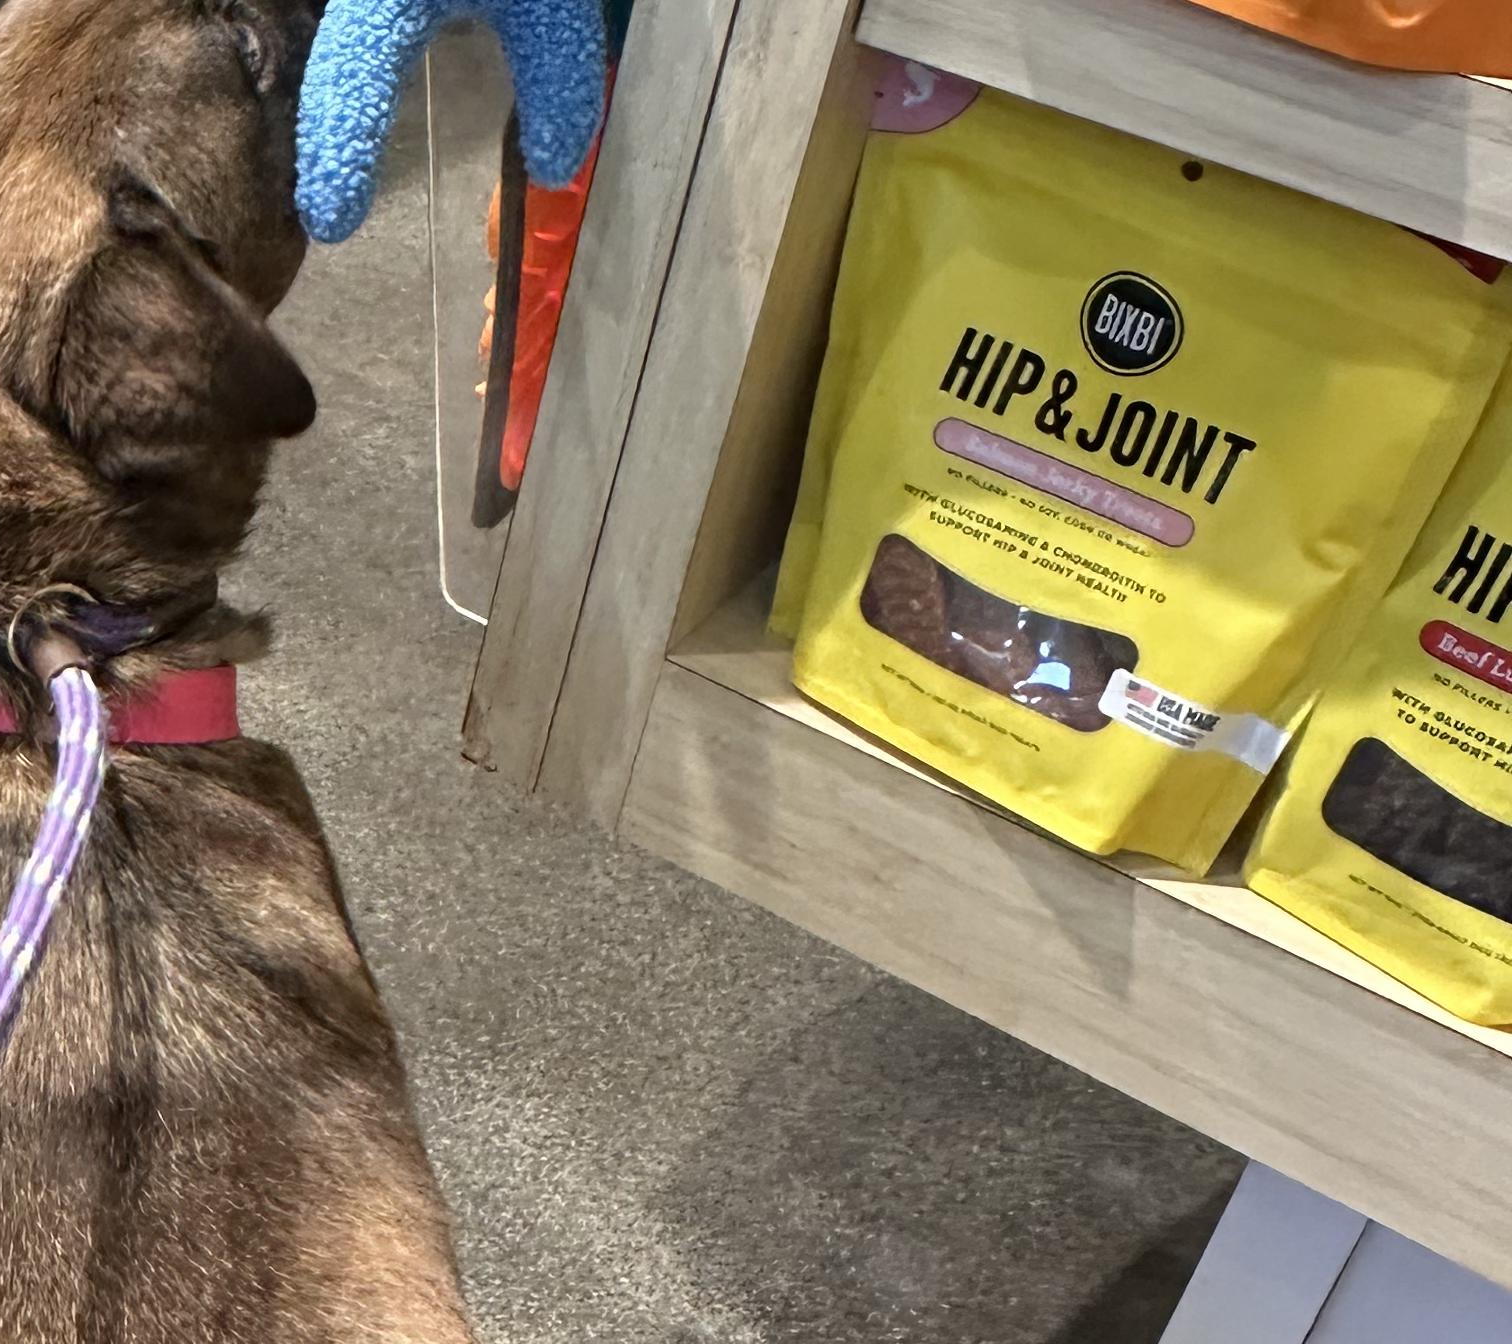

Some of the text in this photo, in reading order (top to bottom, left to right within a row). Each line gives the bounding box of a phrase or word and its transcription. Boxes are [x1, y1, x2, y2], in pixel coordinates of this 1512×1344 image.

[1095, 293, 1165, 355] BIXBI
[939, 327, 1257, 504] HIP & JOINT
[929, 510, 991, 544] SUPPORT
[992, 538, 1018, 553] HIP
[1031, 556, 1074, 578] JOINT
[1075, 573, 1128, 603] HEALTH
[940, 498, 1039, 547] GLUCOSAMINE
[1148, 588, 1167, 604] TO
[1438, 632, 1491, 669] Beef
[1392, 687, 1431, 716] WITH
[1452, 683, 1502, 714] FILLERS
[1397, 708, 1416, 725] TO
[1419, 721, 1493, 764] SUPPORT
